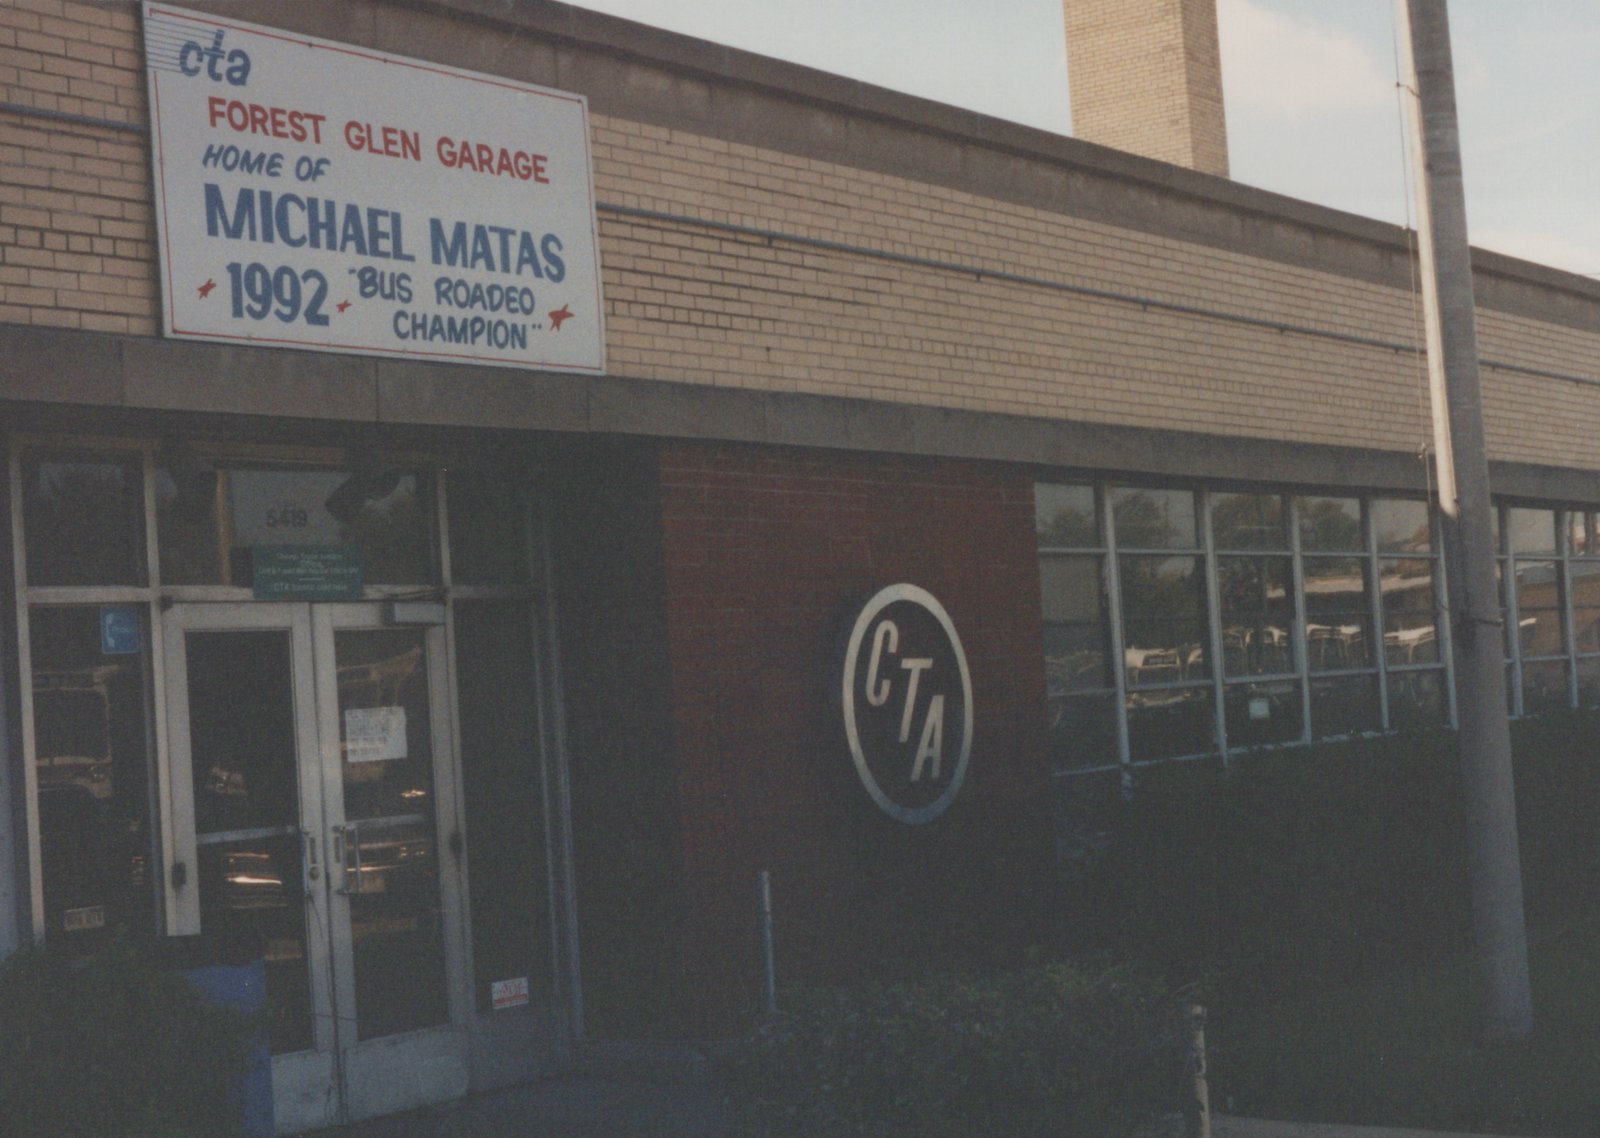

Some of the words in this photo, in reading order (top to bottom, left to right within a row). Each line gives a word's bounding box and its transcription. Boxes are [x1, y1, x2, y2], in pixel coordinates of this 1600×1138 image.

[179, 30, 251, 86] cta
[203, 145, 283, 177] HOME
[296, 156, 331, 181] OF
[208, 97, 325, 144] FOREST
[345, 121, 421, 161] GLEN
[437, 137, 549, 184] GARAGE
[205, 183, 415, 261] MICHAEL
[430, 218, 565, 283] MATAS
[227, 263, 329, 326] 1992
[349, 266, 412, 303] "BUS
[434, 276, 535, 315] ROADEO
[393, 311, 542, 349] CHAMPION"
[866, 620, 944, 781] CTA
